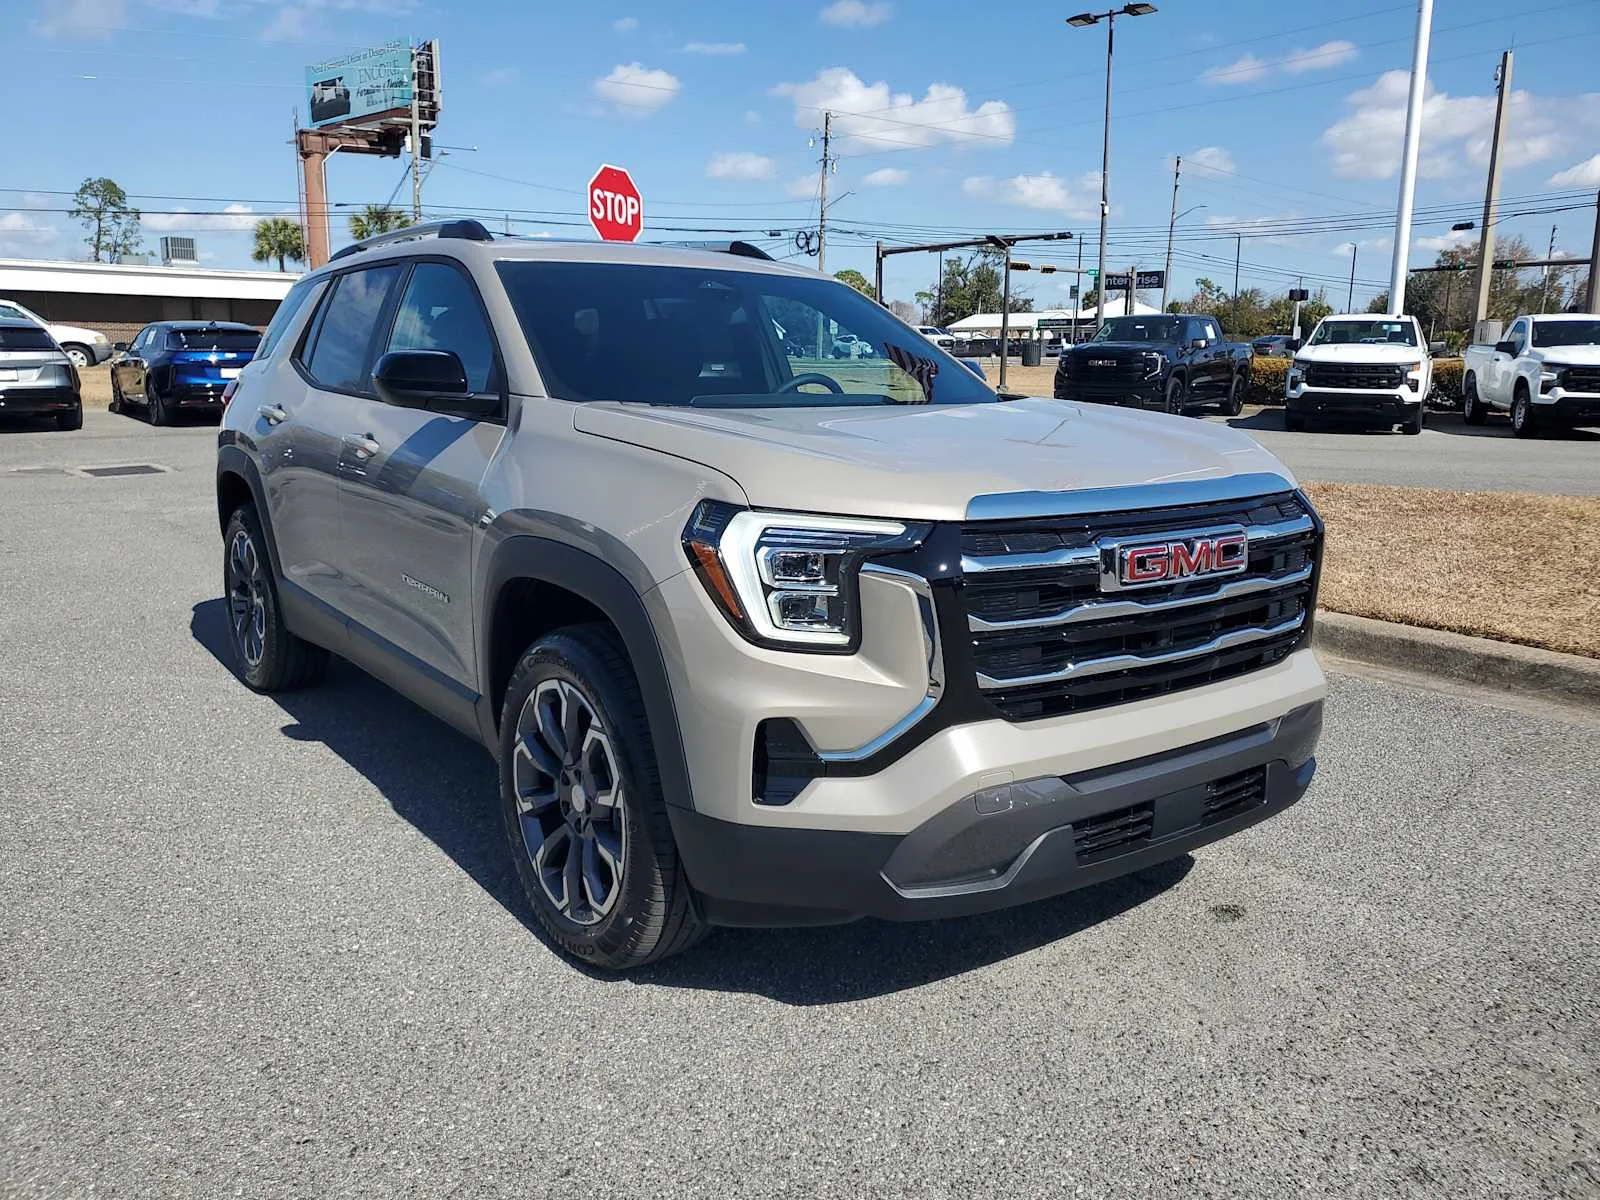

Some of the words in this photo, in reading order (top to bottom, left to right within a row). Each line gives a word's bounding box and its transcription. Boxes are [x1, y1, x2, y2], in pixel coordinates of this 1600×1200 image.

[358, 59, 400, 83] ENCORE
[592, 188, 639, 227] STOP
[1097, 275, 1159, 287] nterrise
[1126, 535, 1247, 582] GMC
